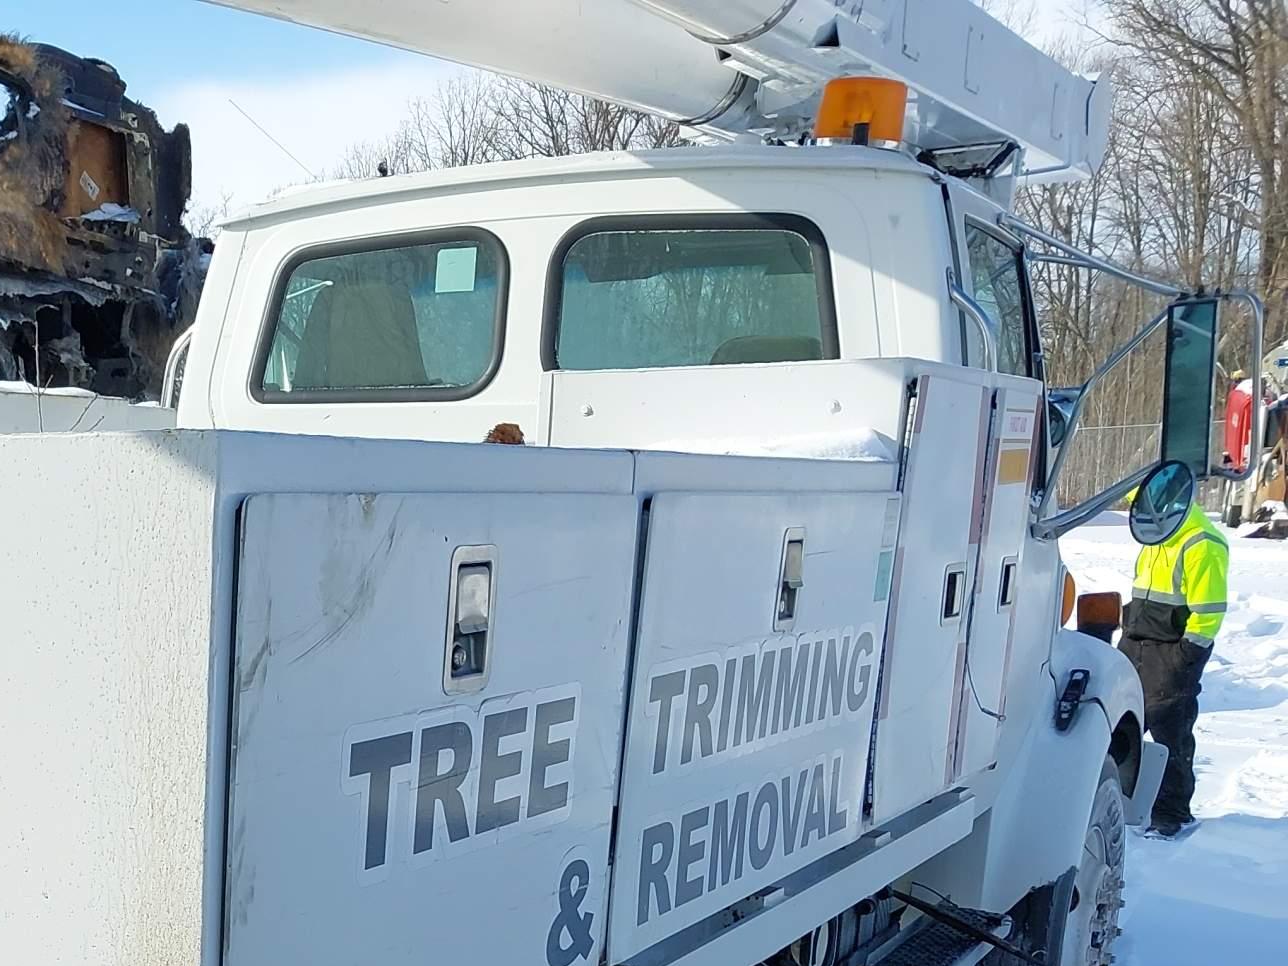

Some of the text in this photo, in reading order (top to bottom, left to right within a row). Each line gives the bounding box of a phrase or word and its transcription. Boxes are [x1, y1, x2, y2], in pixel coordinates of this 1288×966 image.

[348, 631, 874, 871] TREE TRIMMING
[637, 756, 848, 926] REMOVAL
